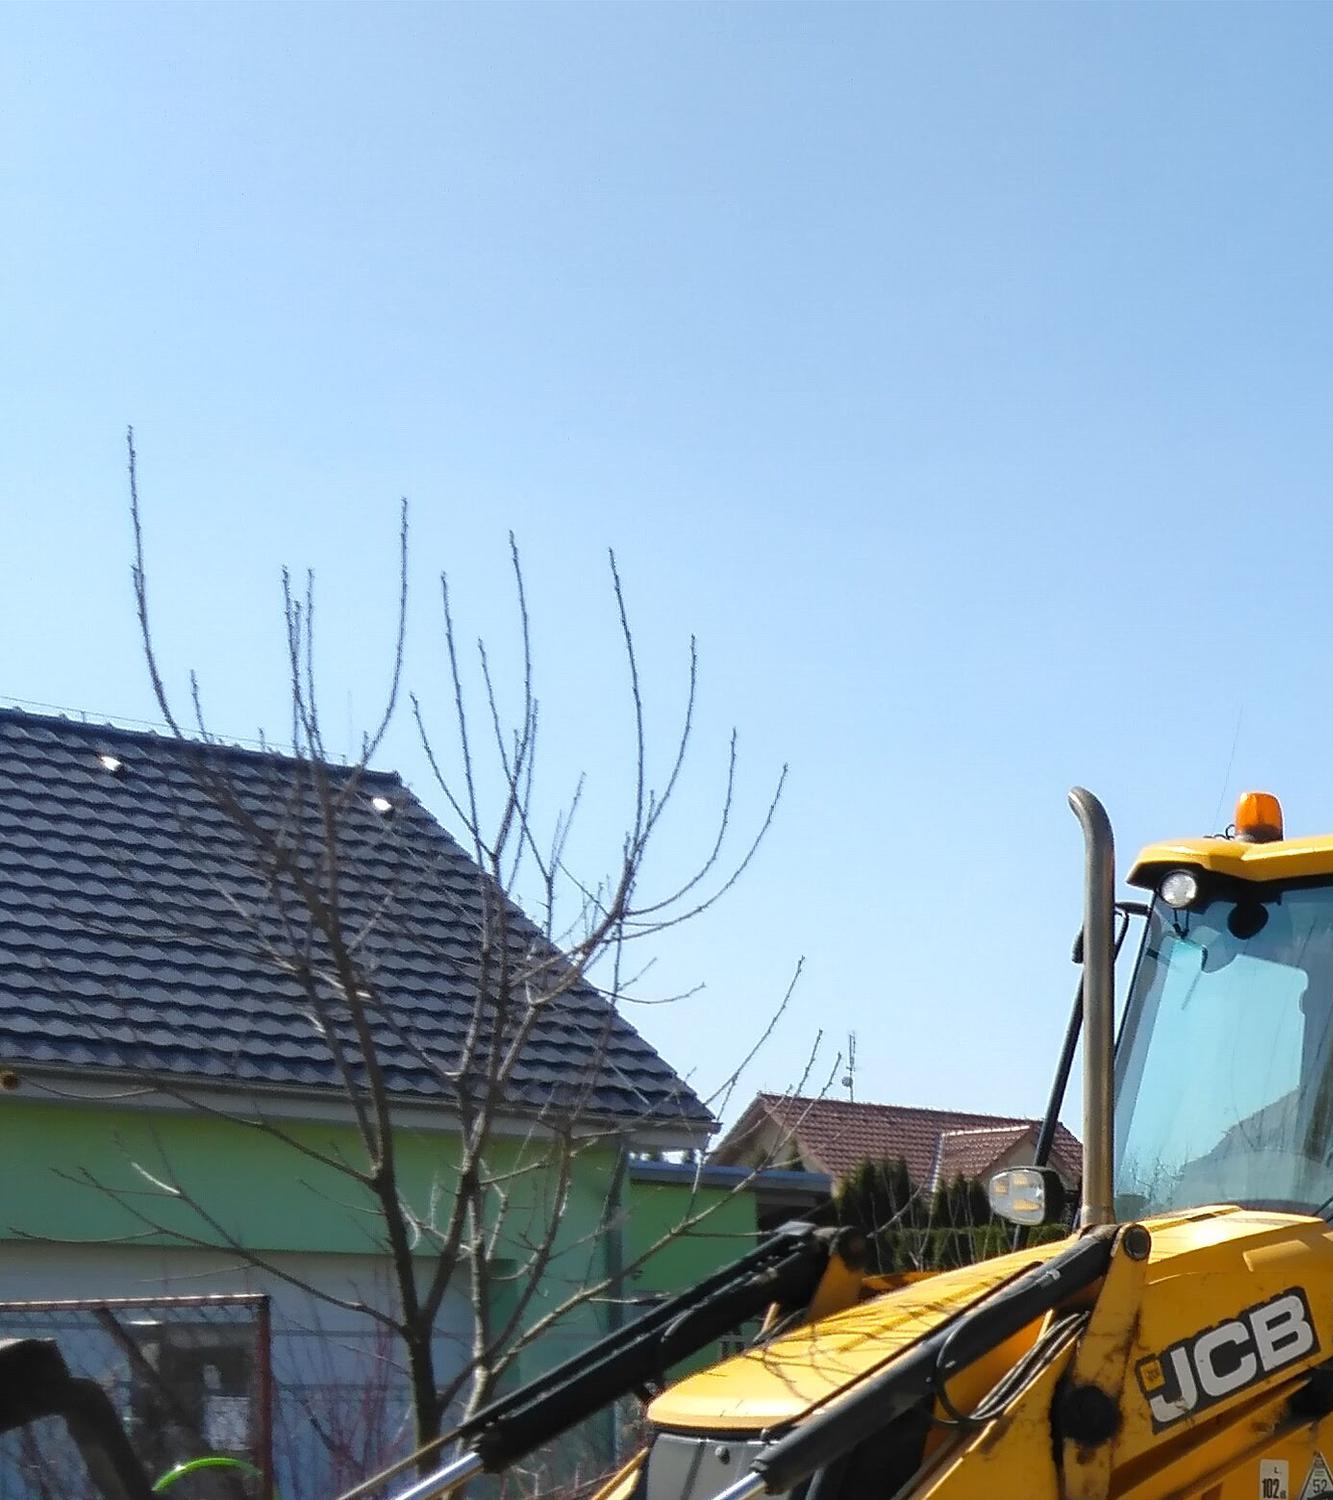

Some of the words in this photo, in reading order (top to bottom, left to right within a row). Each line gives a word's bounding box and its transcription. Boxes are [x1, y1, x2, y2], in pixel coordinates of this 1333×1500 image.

[1150, 1294, 1314, 1422] JCB
[1262, 1478, 1280, 1499] 102
[1313, 1479, 1328, 1494] 52
